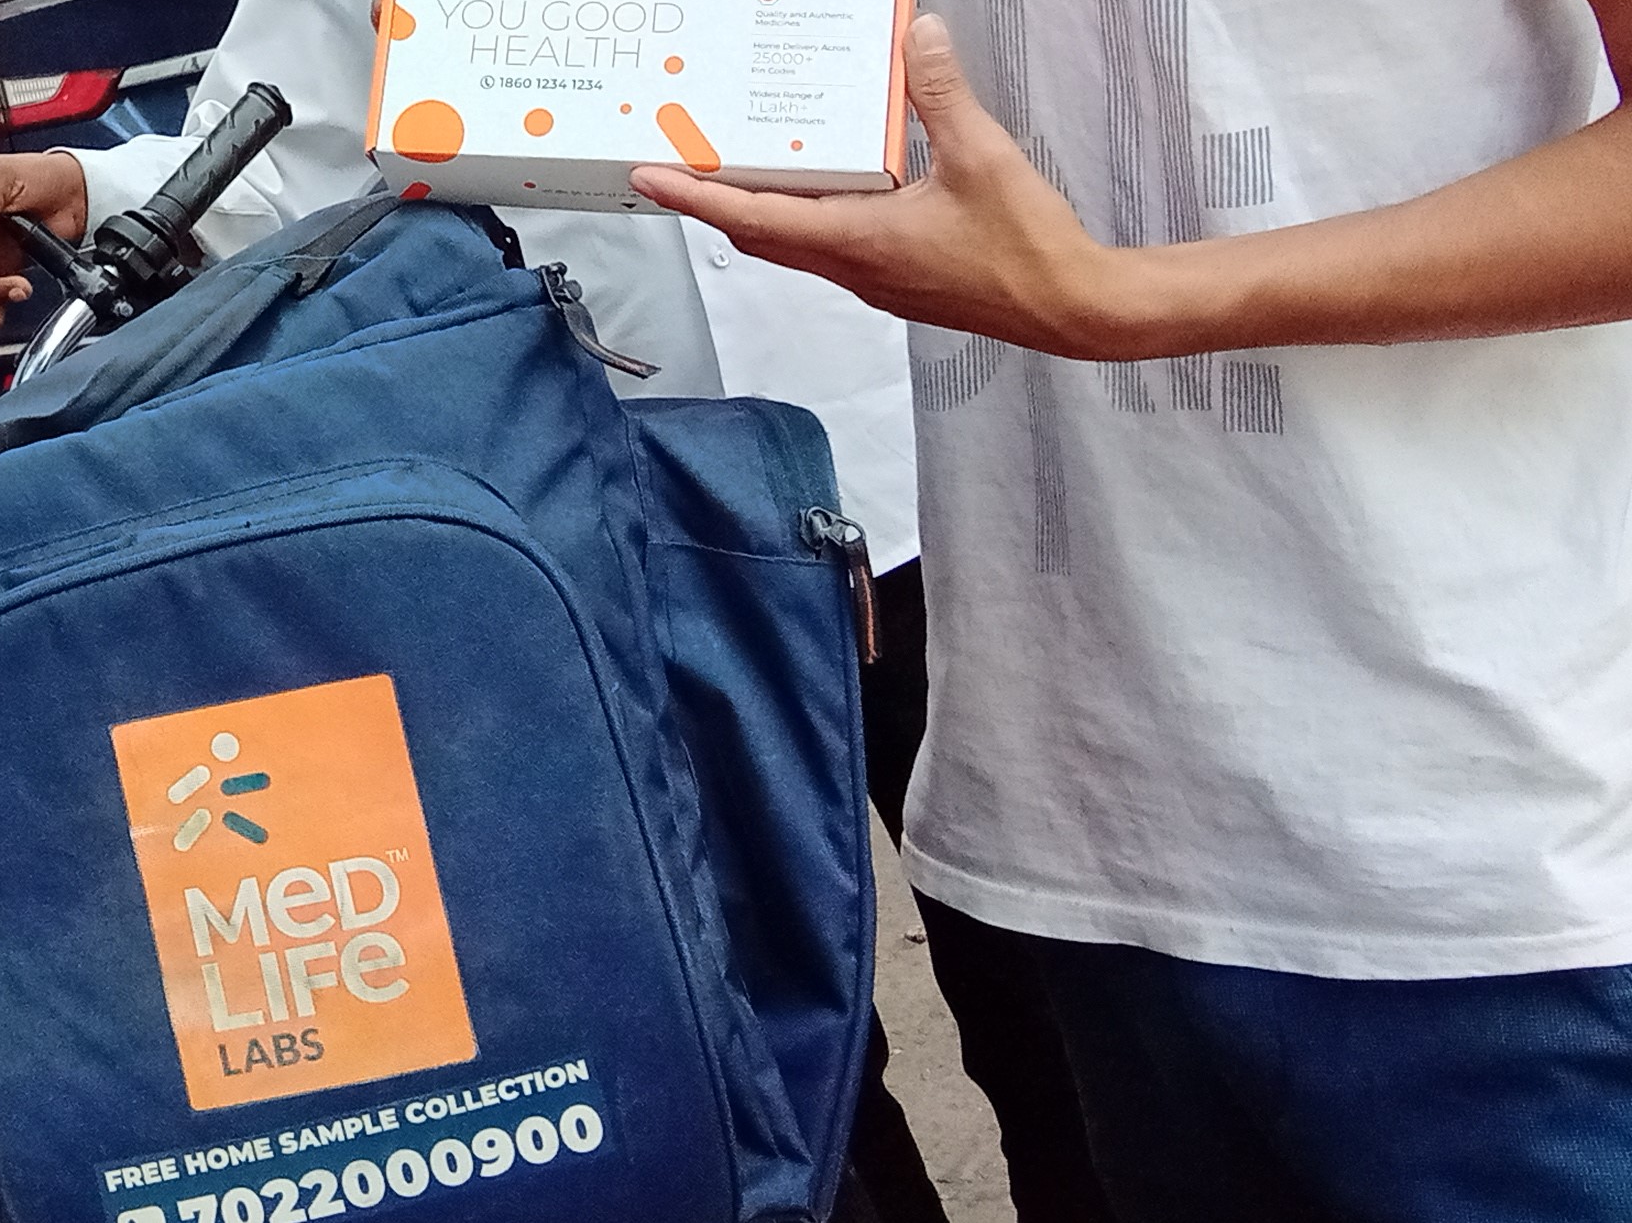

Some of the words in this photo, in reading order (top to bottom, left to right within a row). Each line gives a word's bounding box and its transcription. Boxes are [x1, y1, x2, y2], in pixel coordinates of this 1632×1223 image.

[437, 0, 527, 30] YOU
[542, 1, 684, 33] GOOD
[756, 10, 787, 19] Quality
[470, 35, 641, 68] HEALTH
[821, 44, 851, 52] Across
[500, 77, 532, 89] 1860
[536, 78, 568, 89] 1234
[571, 79, 604, 90] 1234
[783, 91, 812, 100] Range
[747, 115, 783, 124] Medical
[784, 116, 826, 125] Products
[218, 1028, 325, 1077] LABS
[104, 1159, 181, 1194] FREE
[184, 1136, 274, 1176] HOME
[278, 1108, 400, 1155] SAMPLE
[404, 1059, 590, 1125] COLLECTION
[177, 1103, 604, 1223] 7022000900
